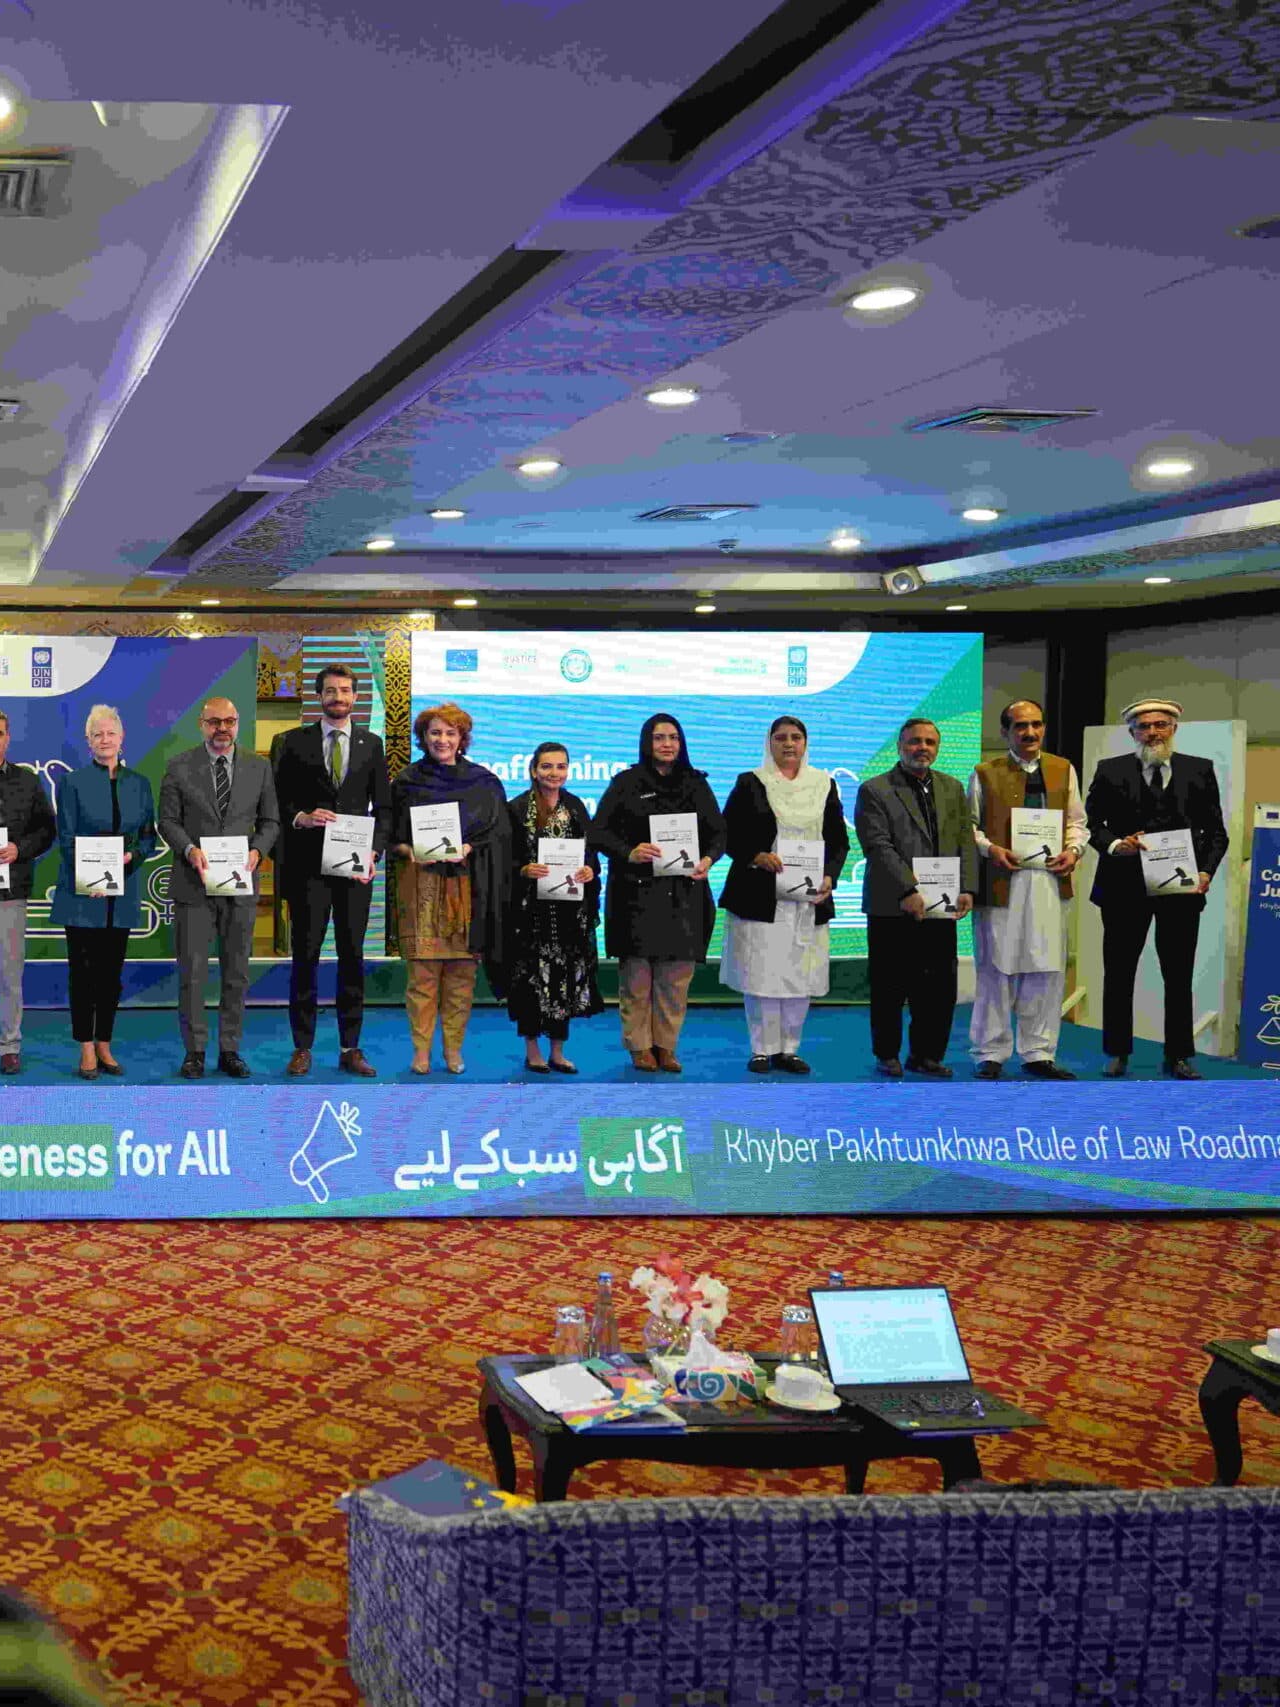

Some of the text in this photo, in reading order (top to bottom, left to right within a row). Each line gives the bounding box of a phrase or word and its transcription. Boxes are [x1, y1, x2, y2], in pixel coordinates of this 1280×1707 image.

[117, 1129, 173, 1177] for
[178, 1129, 231, 1176] All
[453, 1128, 501, 1190] کے
[502, 1148, 577, 1187] سب
[588, 1123, 683, 1192] آگاہی
[724, 1124, 1280, 1173] Khyber Pakhtunkhwa Rule of Law Roadm
